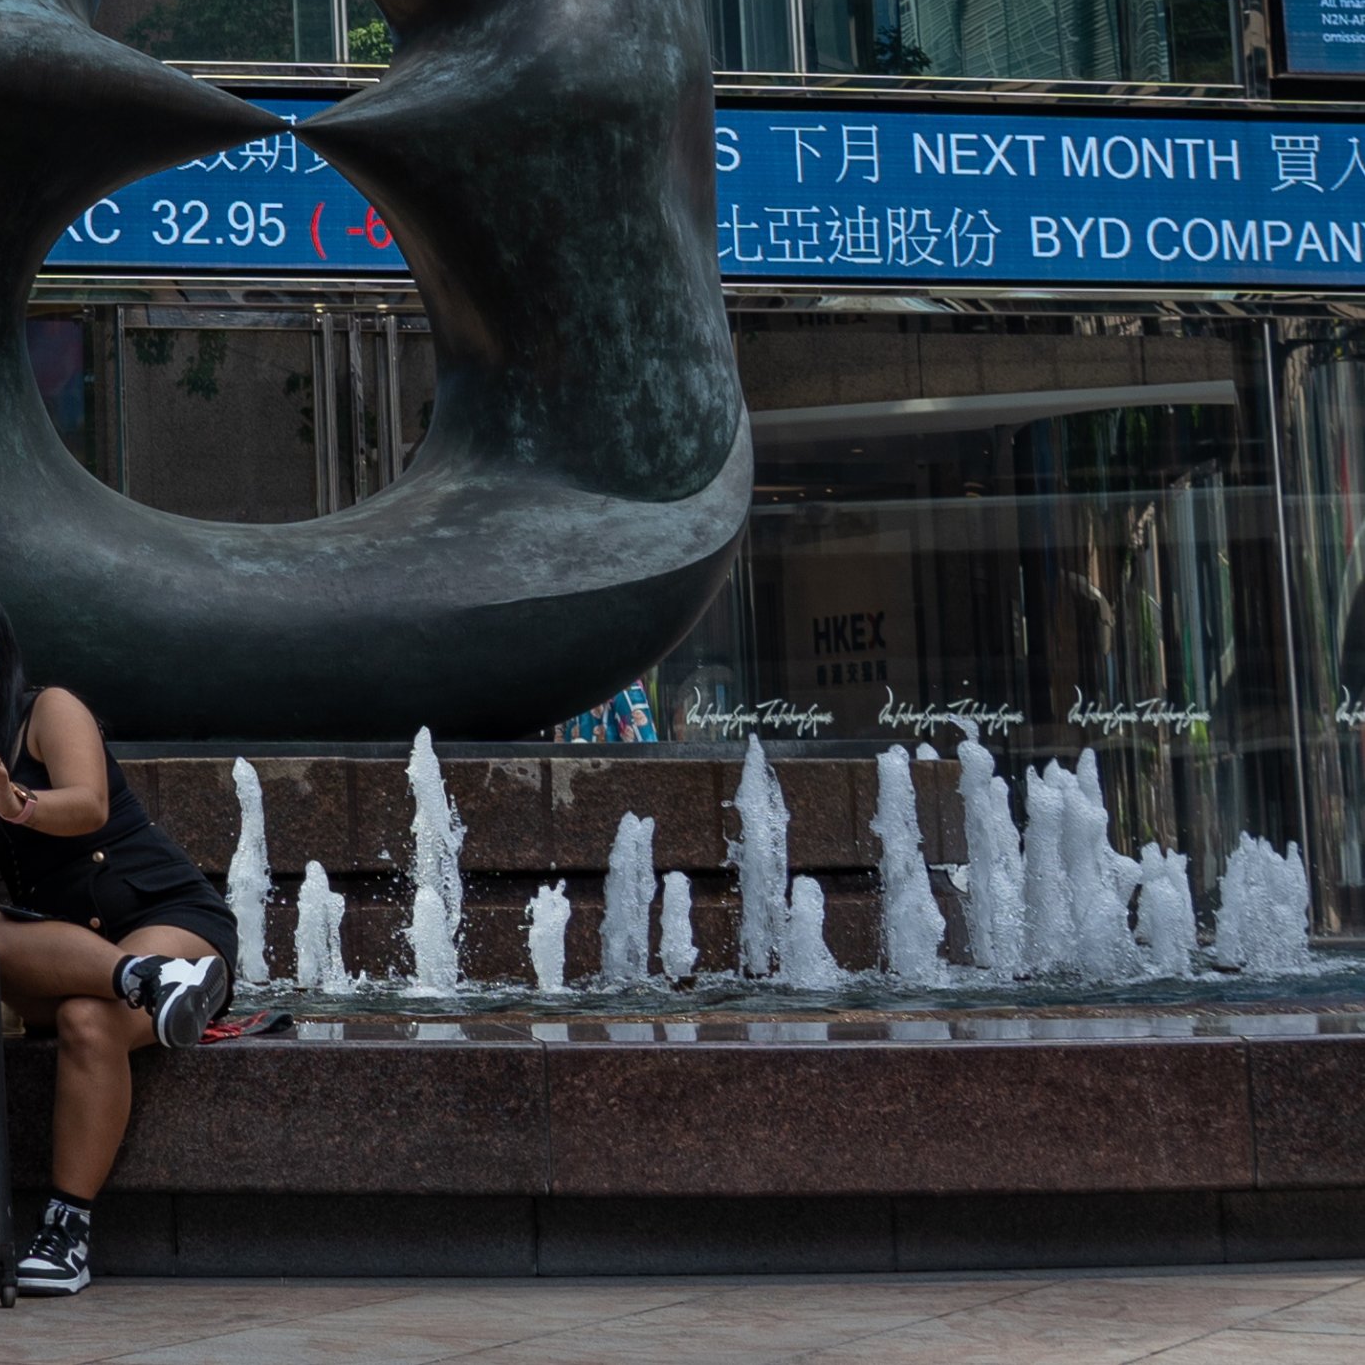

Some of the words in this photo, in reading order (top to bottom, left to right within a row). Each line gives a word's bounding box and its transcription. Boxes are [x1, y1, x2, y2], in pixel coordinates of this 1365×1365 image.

[770, 124, 881, 185] 下月
[913, 133, 1046, 176] NEXT
[1062, 137, 1241, 181] MONTH
[150, 199, 287, 246] 32.95
[719, 204, 1001, 269] 比亞迪股份
[1030, 216, 1130, 260] BYD
[1147, 218, 1365, 264] COMPAN
[813, 611, 887, 656] HKEX
